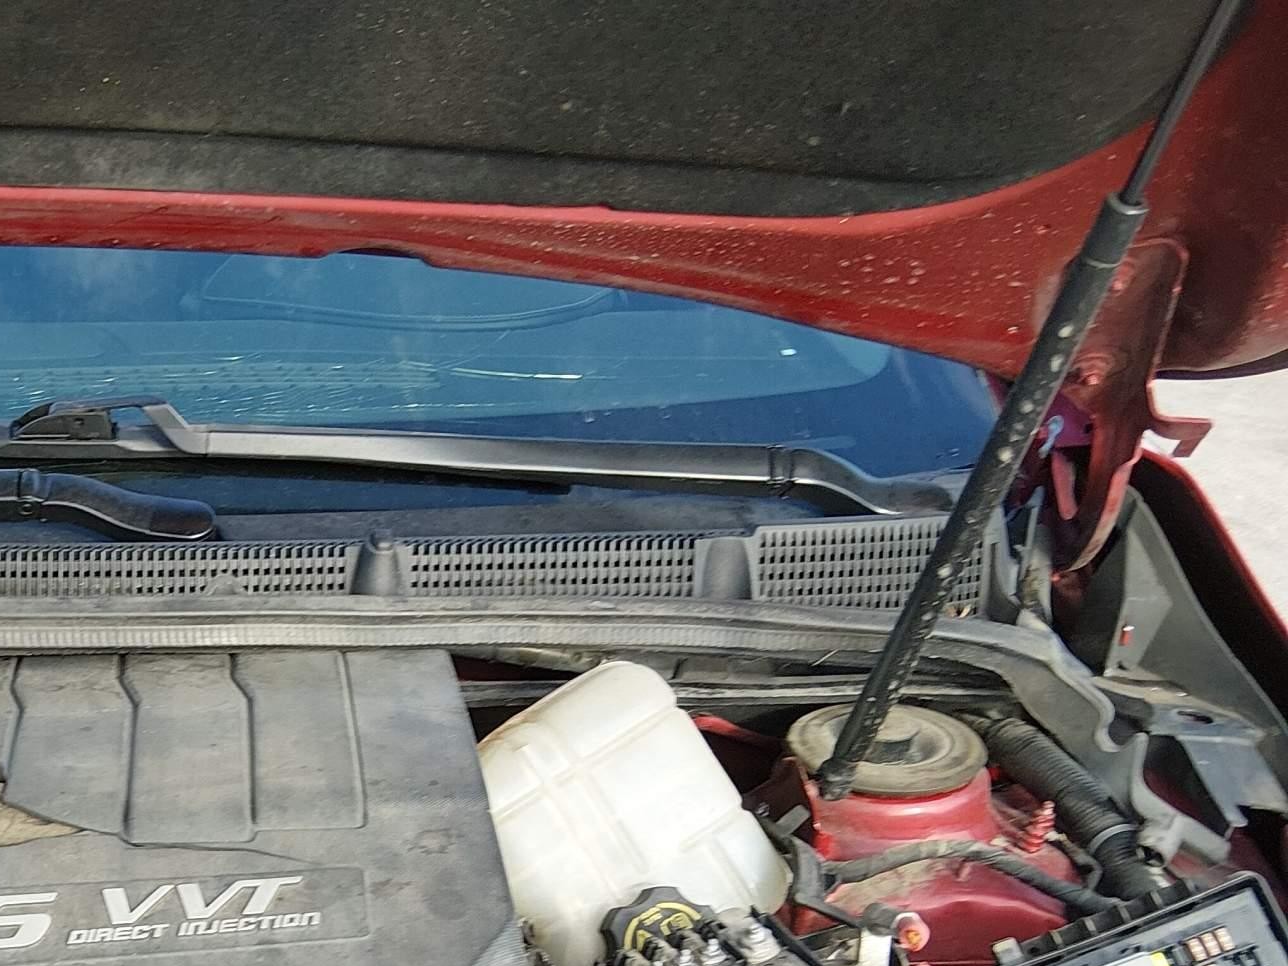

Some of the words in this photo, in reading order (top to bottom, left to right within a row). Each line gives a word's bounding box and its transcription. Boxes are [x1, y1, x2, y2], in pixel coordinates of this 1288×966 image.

[101, 876, 303, 924] VVT
[66, 923, 169, 945] DIRECT
[178, 911, 321, 938] INJECTION
